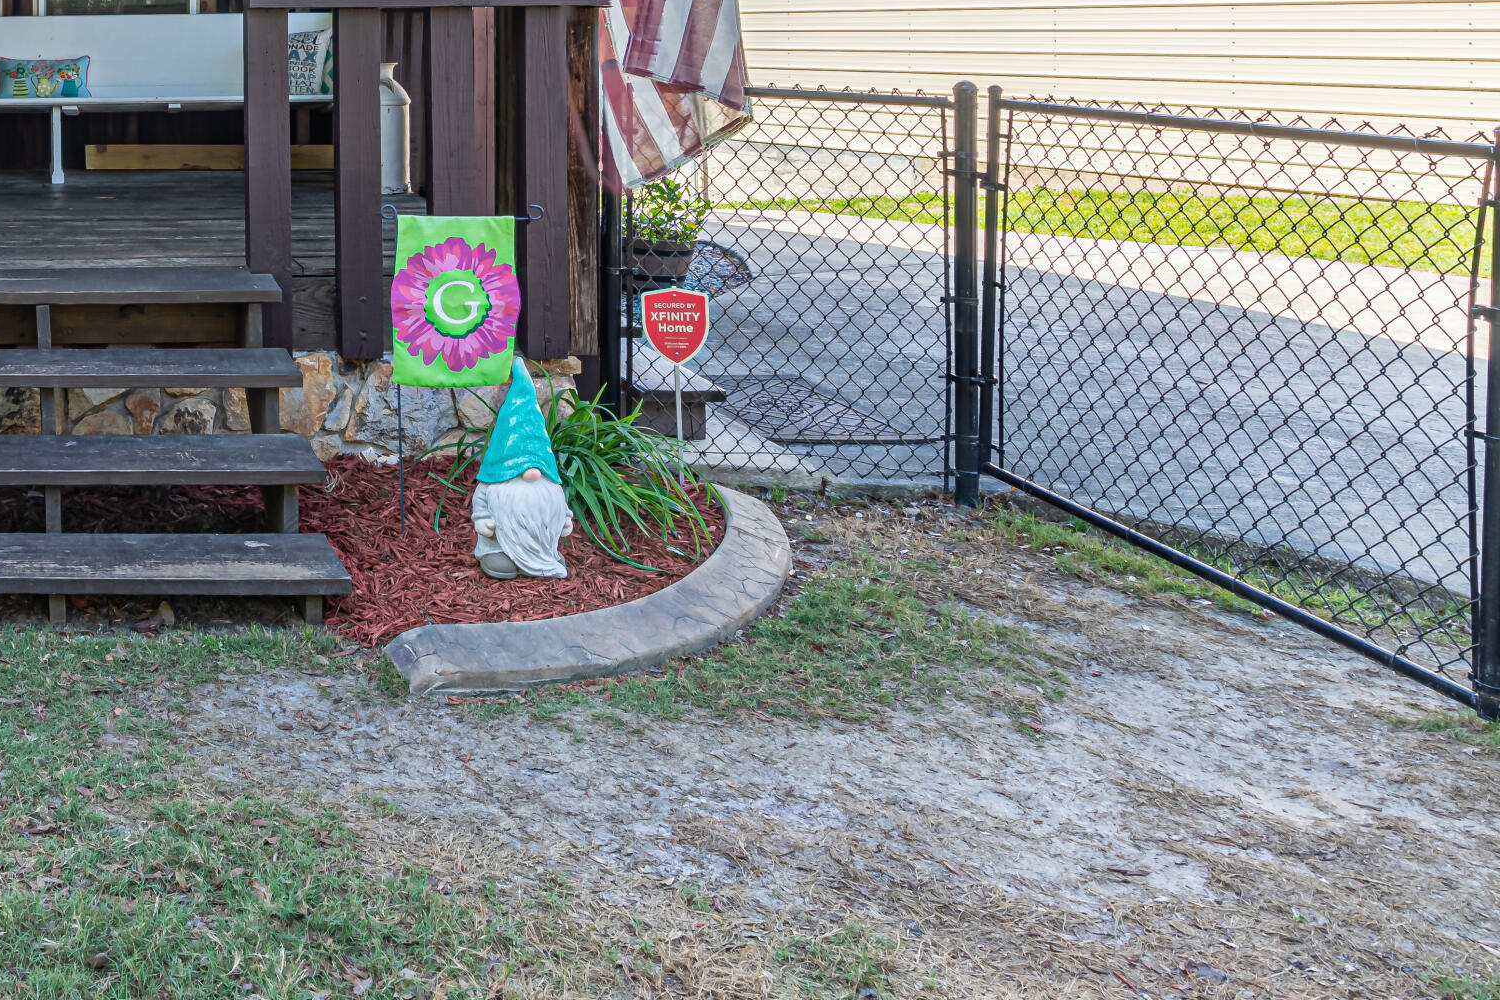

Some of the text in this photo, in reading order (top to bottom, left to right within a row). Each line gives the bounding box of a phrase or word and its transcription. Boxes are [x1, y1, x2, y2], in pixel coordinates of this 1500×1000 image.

[432, 280, 482, 325] G
[650, 311, 701, 322] XFINITY
[658, 323, 694, 333] Home
